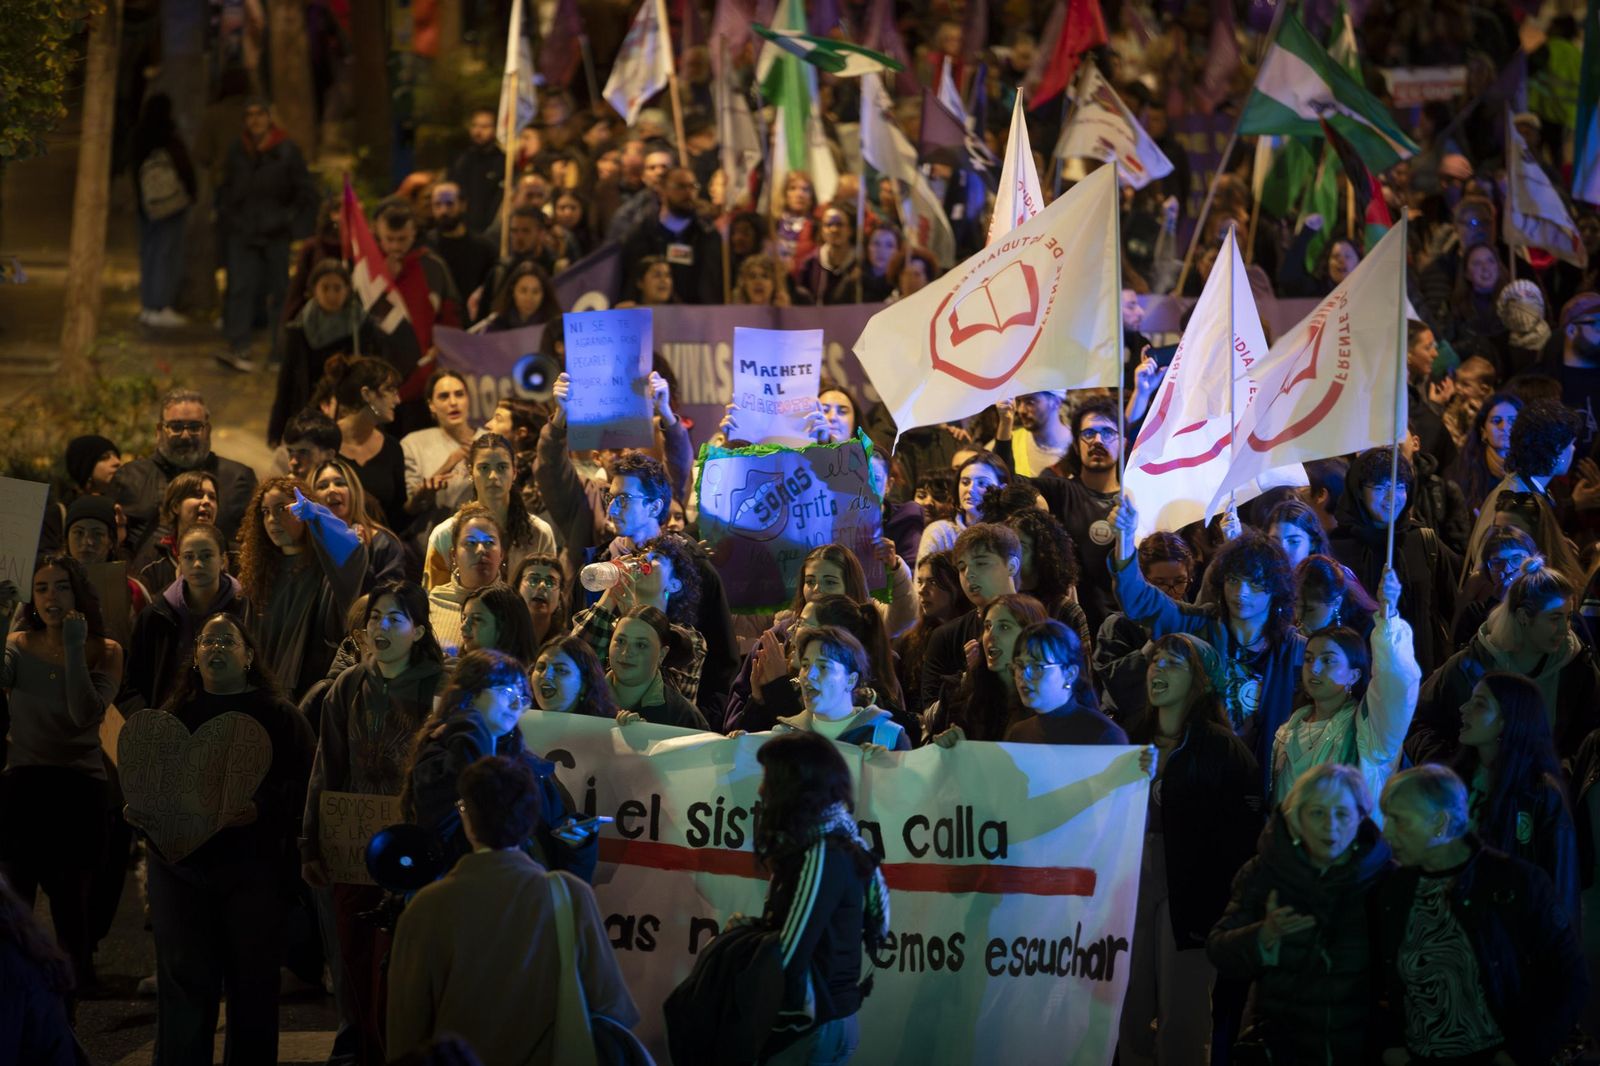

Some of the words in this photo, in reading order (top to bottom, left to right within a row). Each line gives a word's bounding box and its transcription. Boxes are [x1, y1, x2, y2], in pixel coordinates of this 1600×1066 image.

[569, 322, 583, 333] NI
[740, 359, 813, 378] MACHETE
[763, 383, 786, 396] AL
[753, 466, 813, 524] SOMOS
[824, 449, 849, 480] el
[792, 489, 839, 531] grito
[849, 486, 871, 512] de
[326, 797, 375, 821] SOMOS
[616, 794, 661, 842] el
[903, 805, 1009, 860] calla
[985, 922, 1129, 982] escuchar
